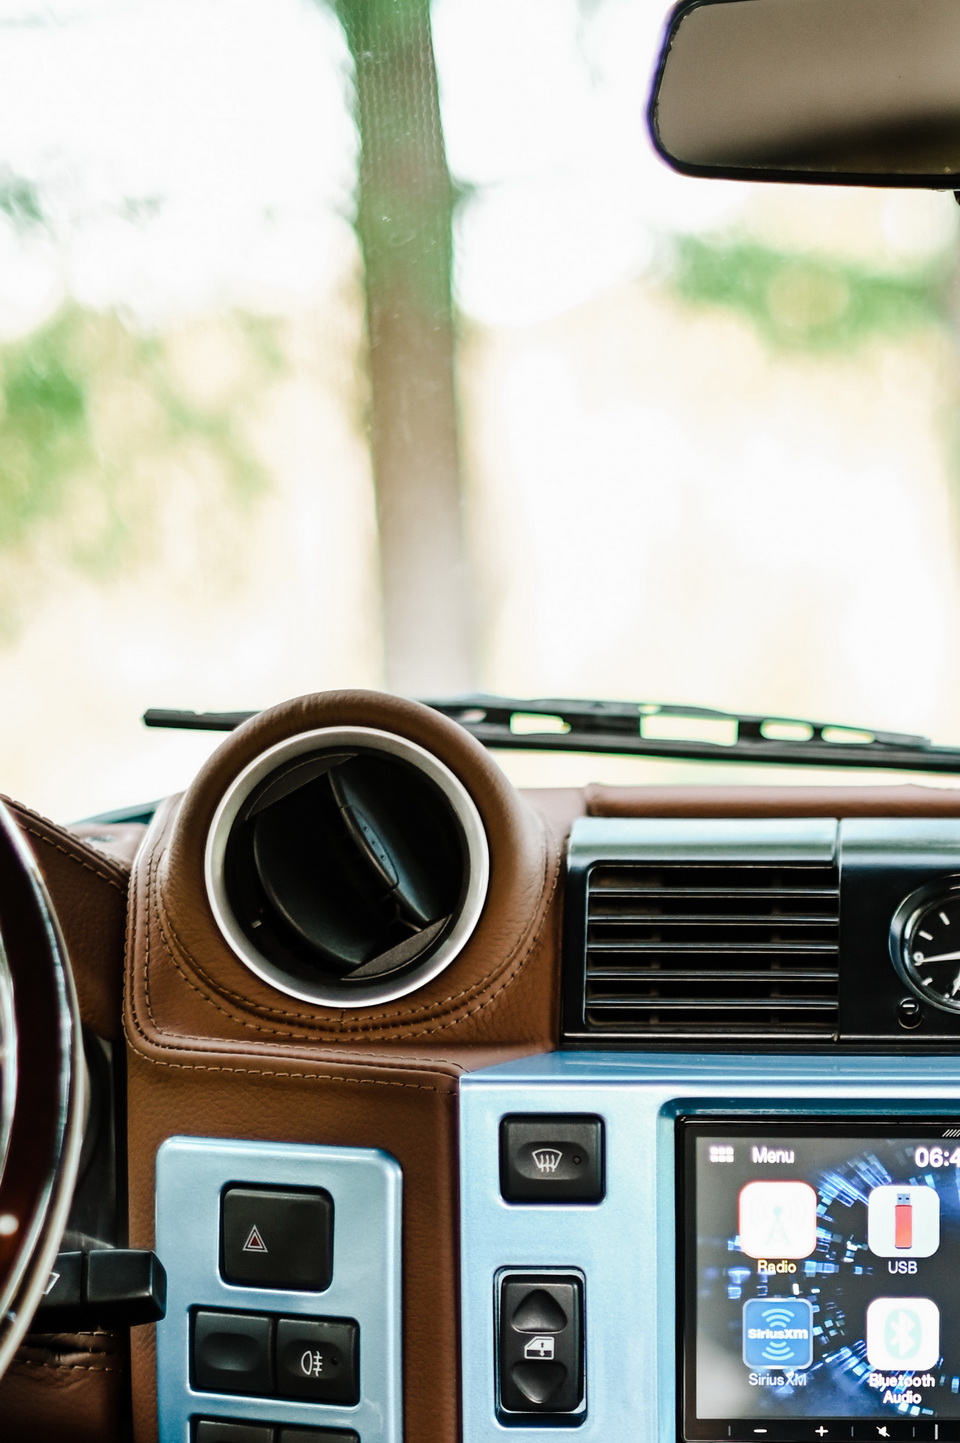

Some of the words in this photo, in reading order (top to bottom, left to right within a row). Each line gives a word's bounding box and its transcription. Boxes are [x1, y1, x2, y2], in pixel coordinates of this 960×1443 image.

[913, 951, 924, 967] 9
[752, 1145, 795, 1164] Menu
[757, 1259, 797, 1274] Radio
[887, 1260, 918, 1275] USB
[868, 1373, 935, 1388] Bluetooth
[882, 1390, 922, 1405] Audio
